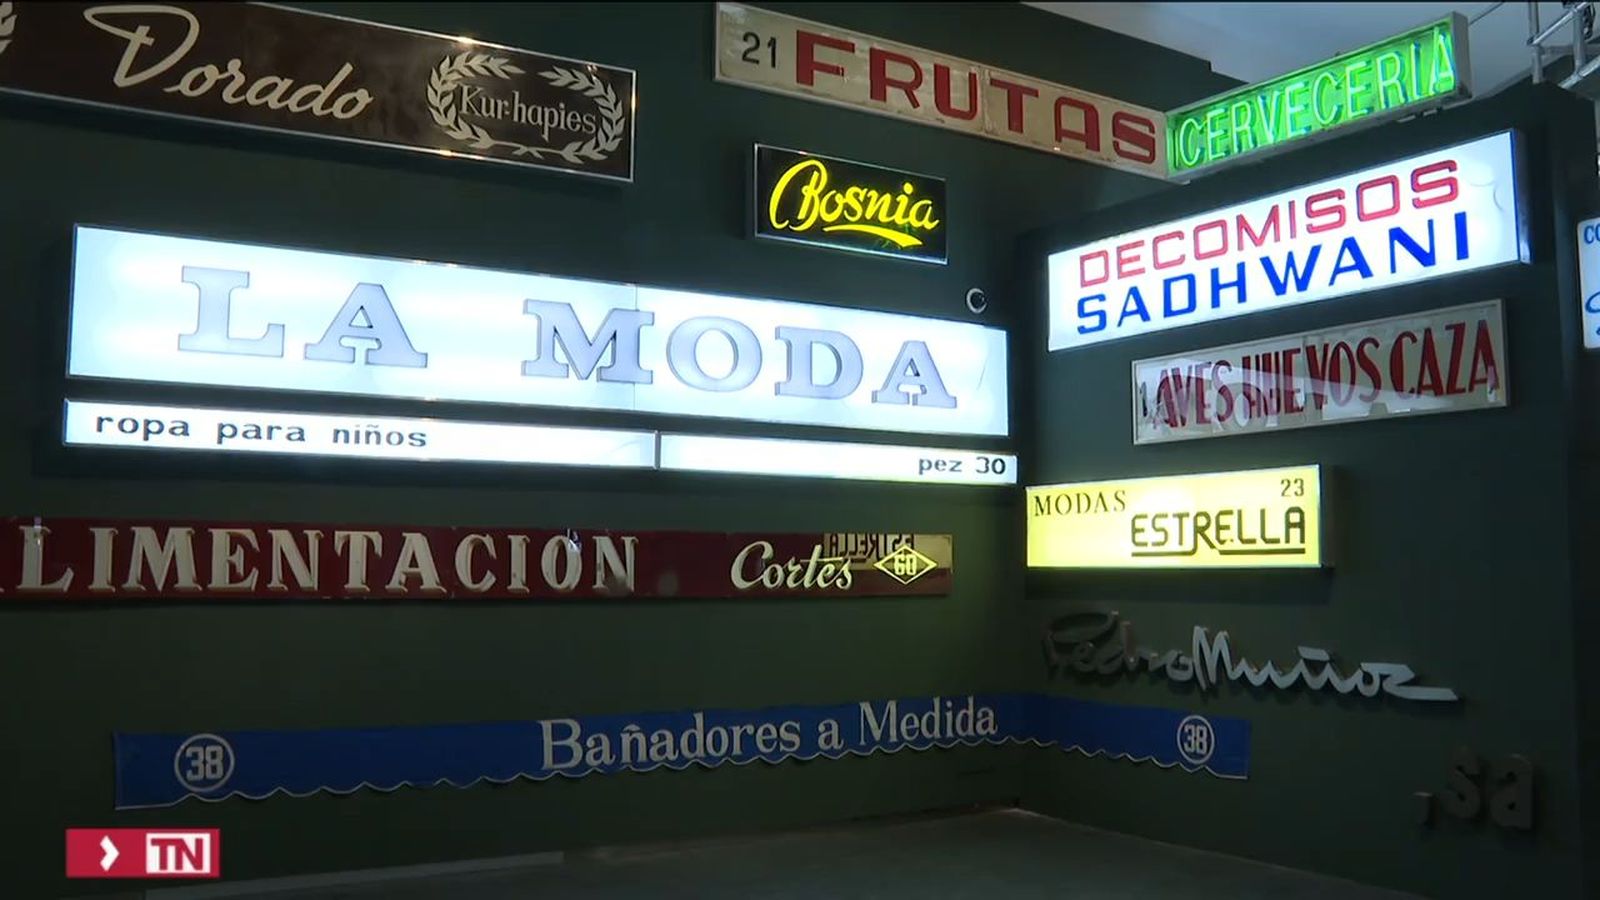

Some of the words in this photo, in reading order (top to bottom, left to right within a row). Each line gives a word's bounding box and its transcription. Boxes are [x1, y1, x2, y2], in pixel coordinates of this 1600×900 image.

[84, 5, 373, 119] Dorado
[741, 32, 777, 68] 21
[796, 29, 1155, 163] FRUTAS
[1180, 27, 1456, 166] CERVECERIA
[769, 159, 939, 231] Bosnia
[1080, 159, 1459, 288] DECOMISOS
[1076, 211, 1469, 335] SADHWANI
[177, 265, 428, 368] LA
[521, 298, 957, 408] MODA
[1152, 360, 1234, 429] AVES
[1241, 337, 1382, 419] HUEVOS
[1389, 319, 1500, 400] CAZA
[95, 415, 190, 439] ropa
[217, 422, 306, 445] para
[332, 424, 427, 448] niños
[918, 457, 962, 475] pez
[975, 457, 1006, 475] 30
[1034, 490, 1127, 516] MODAS
[1280, 478, 1305, 498] 23
[0, 525, 639, 593] LIMENTACION
[894, 554, 917, 576] 60
[1131, 507, 1306, 555] ESTRELLA
[186, 745, 224, 781] 38
[539, 712, 802, 770] Bañadores
[817, 718, 844, 751] a
[858, 696, 998, 746] Medida
[1184, 725, 1208, 754] 38
